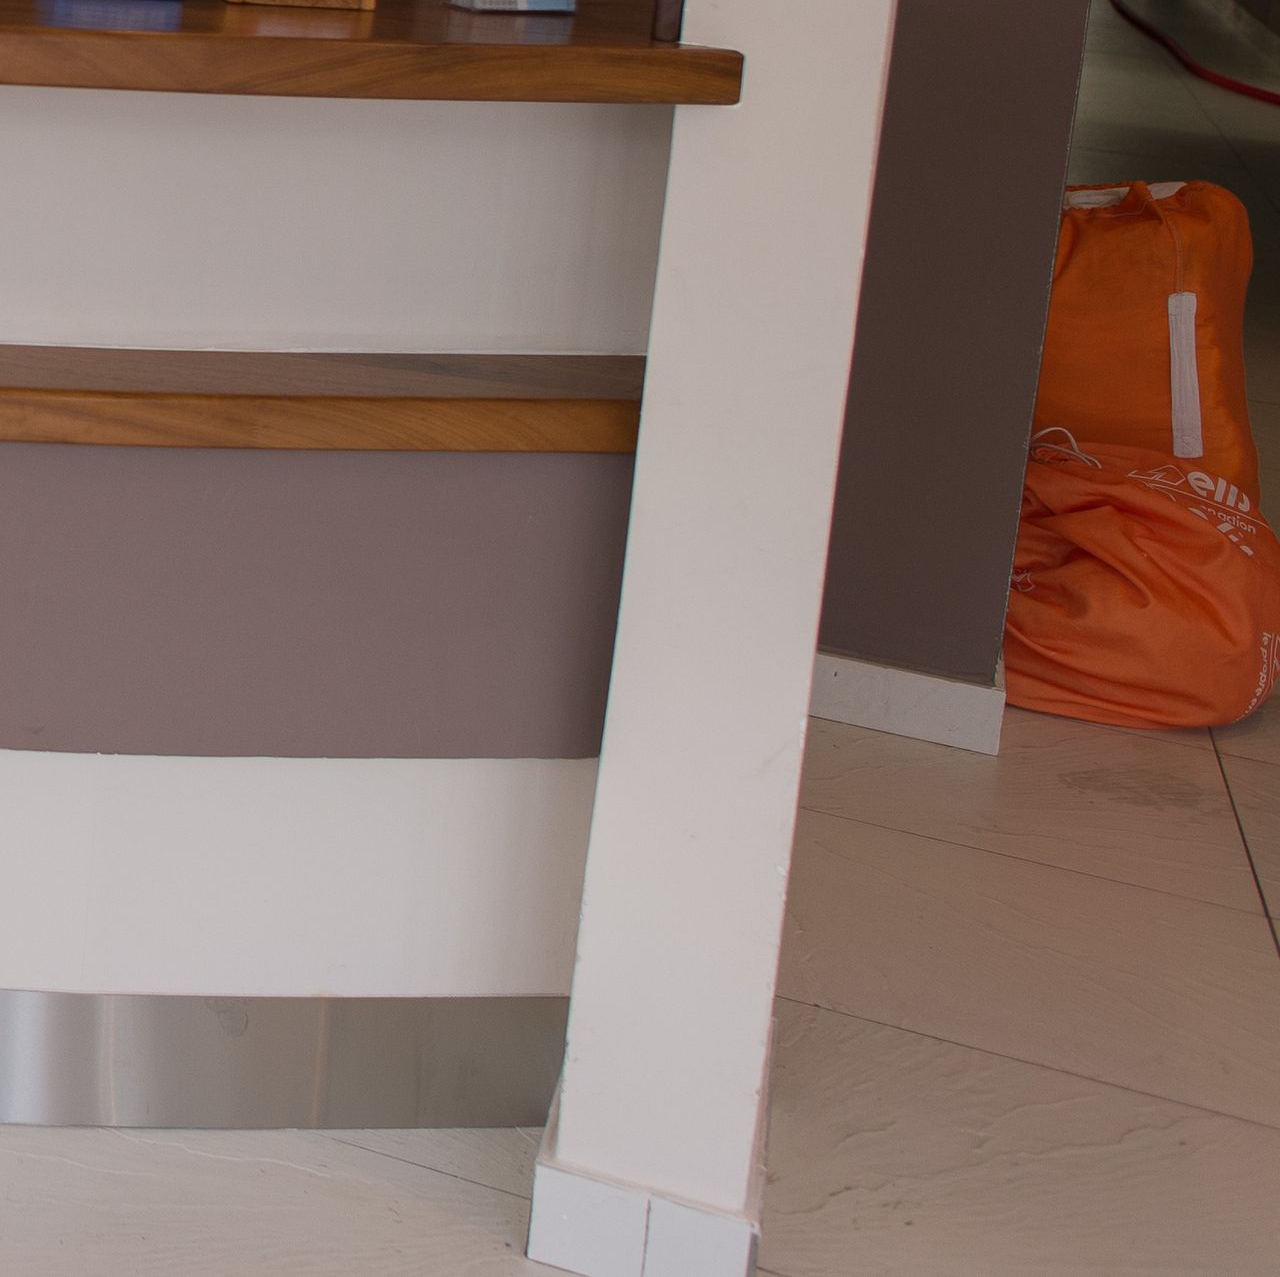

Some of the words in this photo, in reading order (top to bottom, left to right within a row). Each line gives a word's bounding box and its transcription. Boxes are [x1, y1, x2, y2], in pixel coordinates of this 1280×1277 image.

[1217, 511, 1256, 535] action
[1262, 631, 1272, 645] le
[1255, 646, 1268, 696] propre
